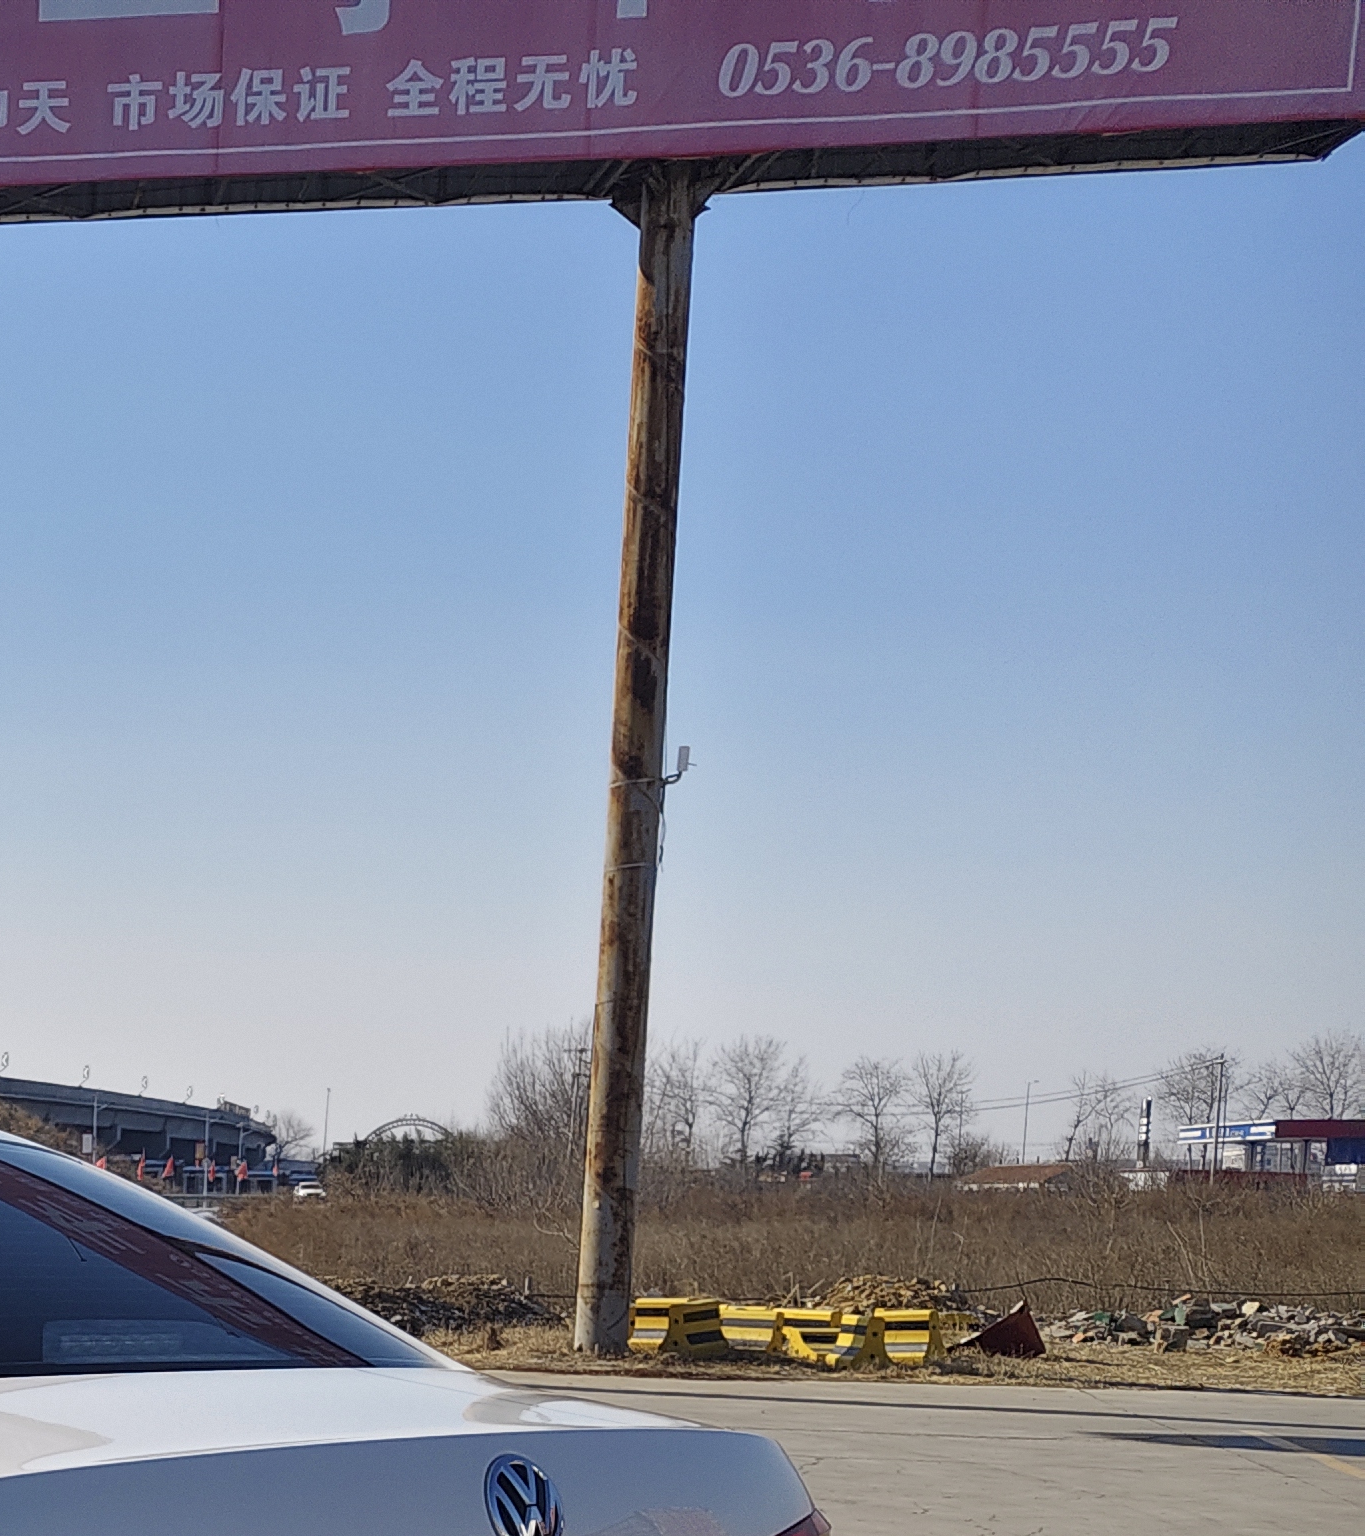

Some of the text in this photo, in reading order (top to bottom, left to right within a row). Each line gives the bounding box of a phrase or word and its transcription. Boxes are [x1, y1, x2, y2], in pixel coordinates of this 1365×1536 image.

[107, 66, 352, 131] 市场保证
[385, 47, 638, 118] 全程无忧
[718, 17, 1178, 97] 0536-8985555
